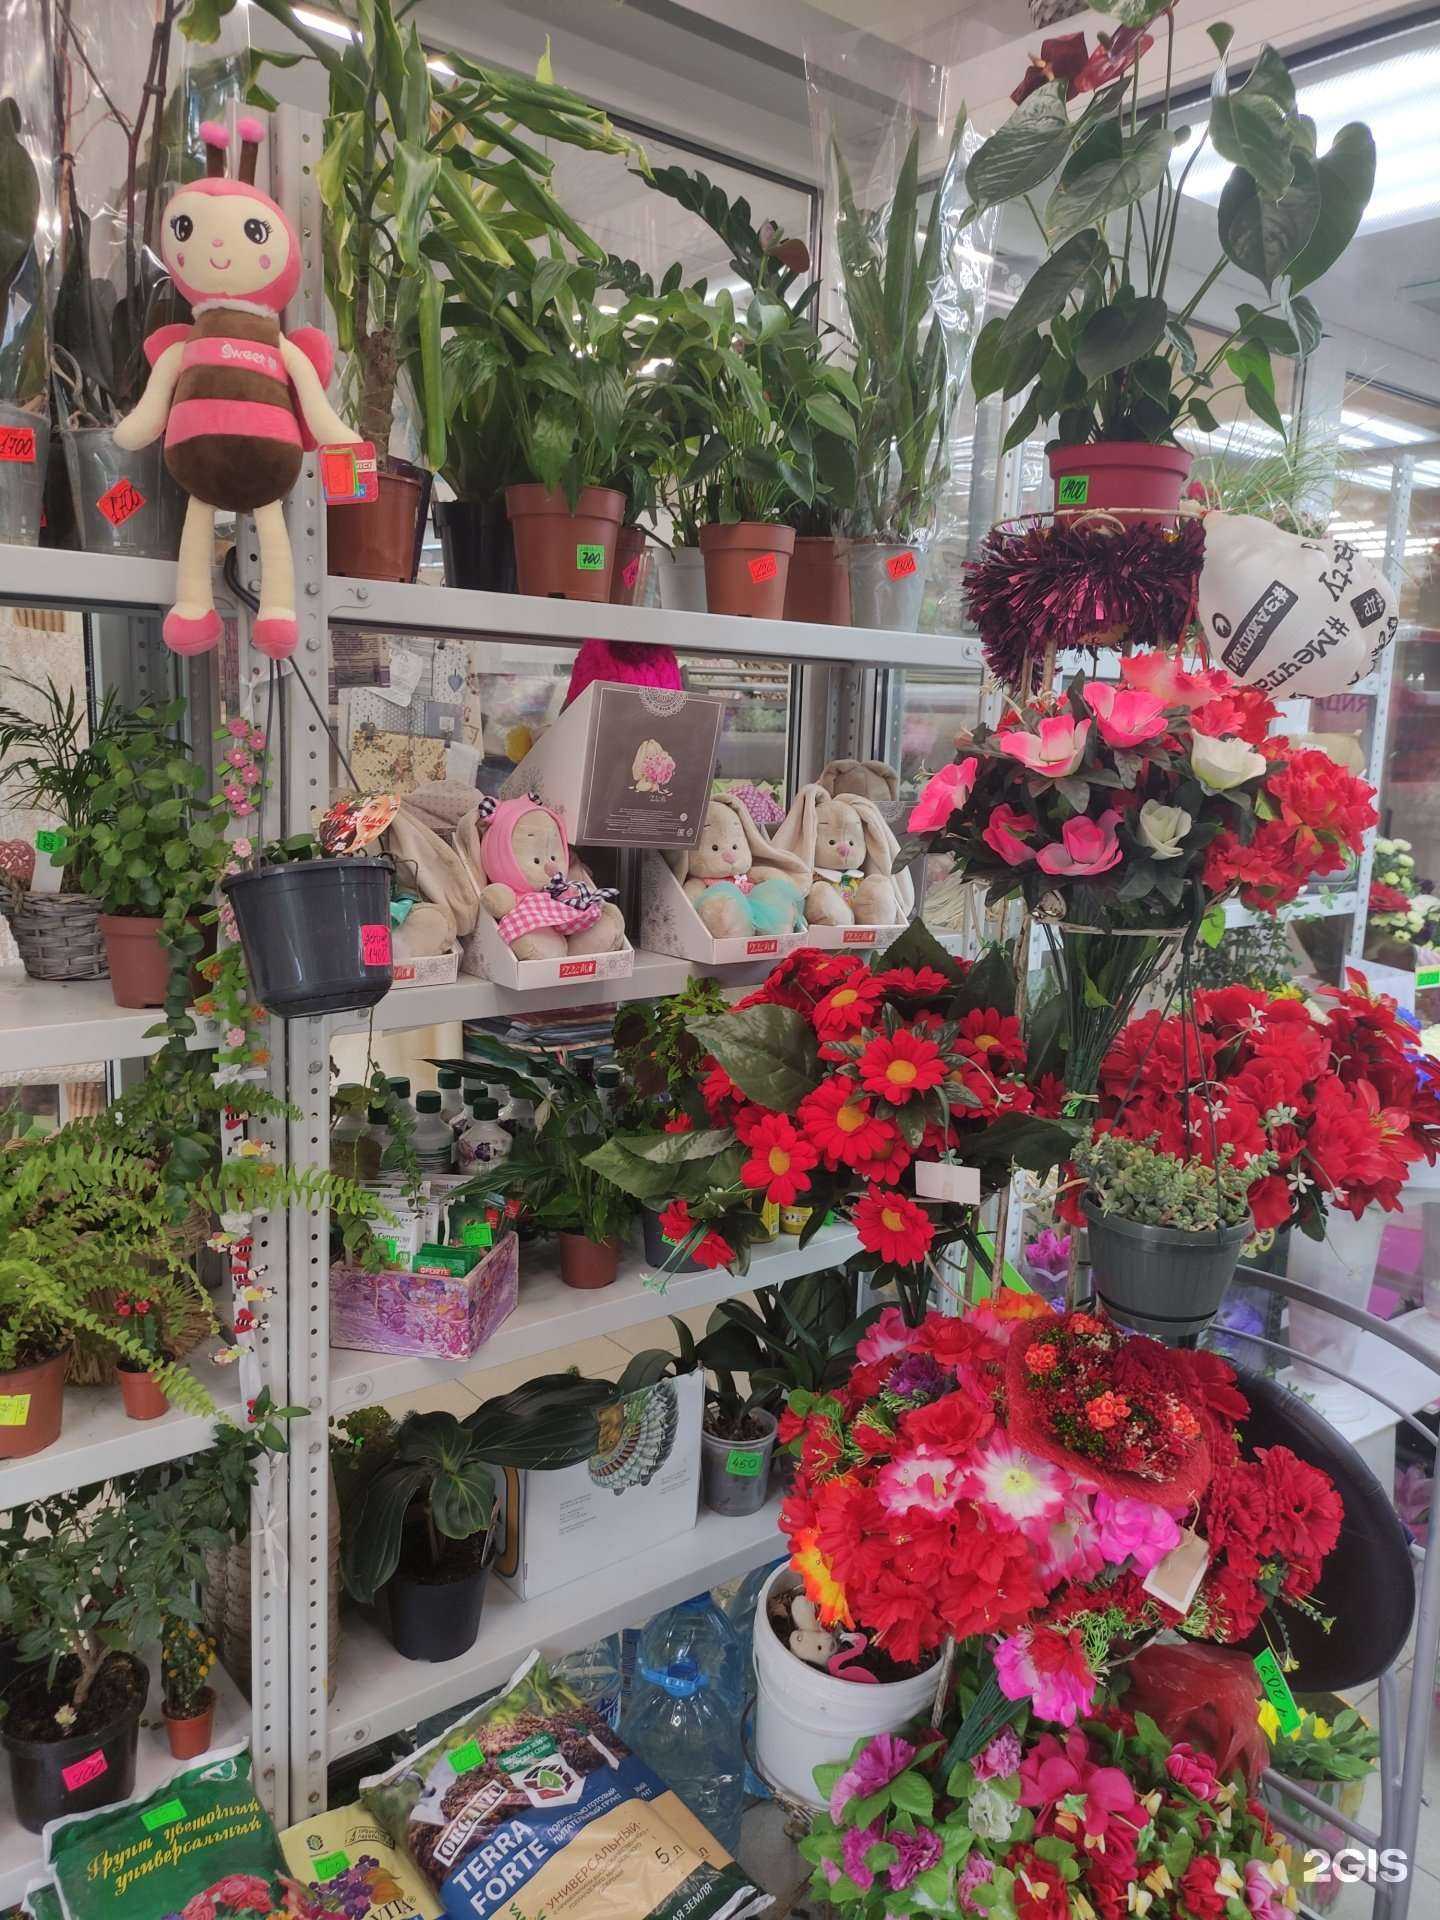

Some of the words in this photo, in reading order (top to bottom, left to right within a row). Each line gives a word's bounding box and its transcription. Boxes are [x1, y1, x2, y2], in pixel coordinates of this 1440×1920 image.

[582, 551, 601, 565] 700
[732, 1455, 758, 1469] 450
[86, 1836, 154, 1882] Грунт
[164, 1798, 261, 1845] цветочный
[114, 1815, 262, 1897] универсальный
[452, 1820, 533, 1892] TERRA
[655, 1847, 670, 1865] 5
[470, 1838, 549, 1916] FORTE
[682, 1881, 713, 1915] ЗЕМЛЯ
